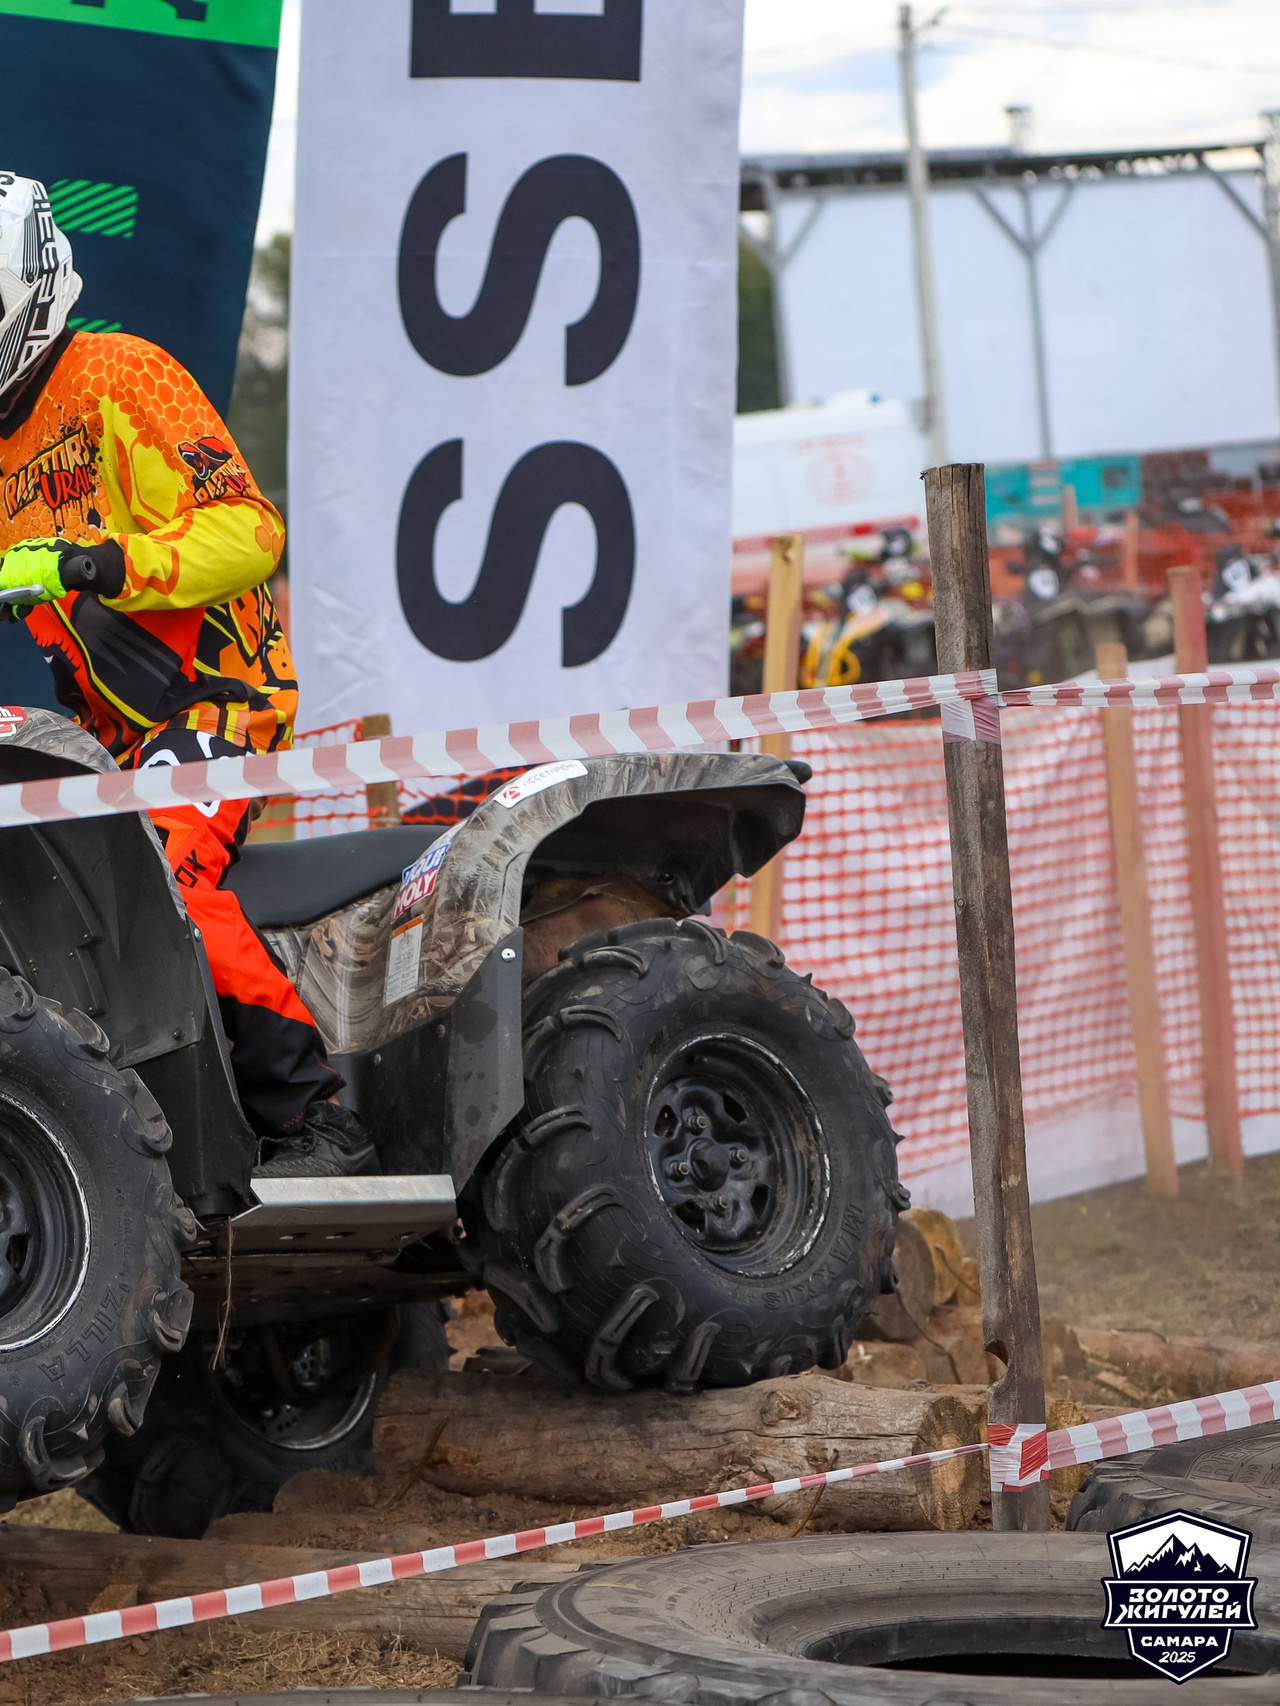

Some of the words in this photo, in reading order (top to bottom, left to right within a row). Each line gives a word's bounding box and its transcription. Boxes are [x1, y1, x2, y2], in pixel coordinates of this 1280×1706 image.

[5, 428, 90, 518] RAPTORS
[41, 466, 93, 508] URAL
[174, 849, 207, 888] OX
[392, 870, 437, 920] MOLY
[762, 1204, 864, 1311] MAXXIS
[38, 1287, 127, 1382] ZILLA
